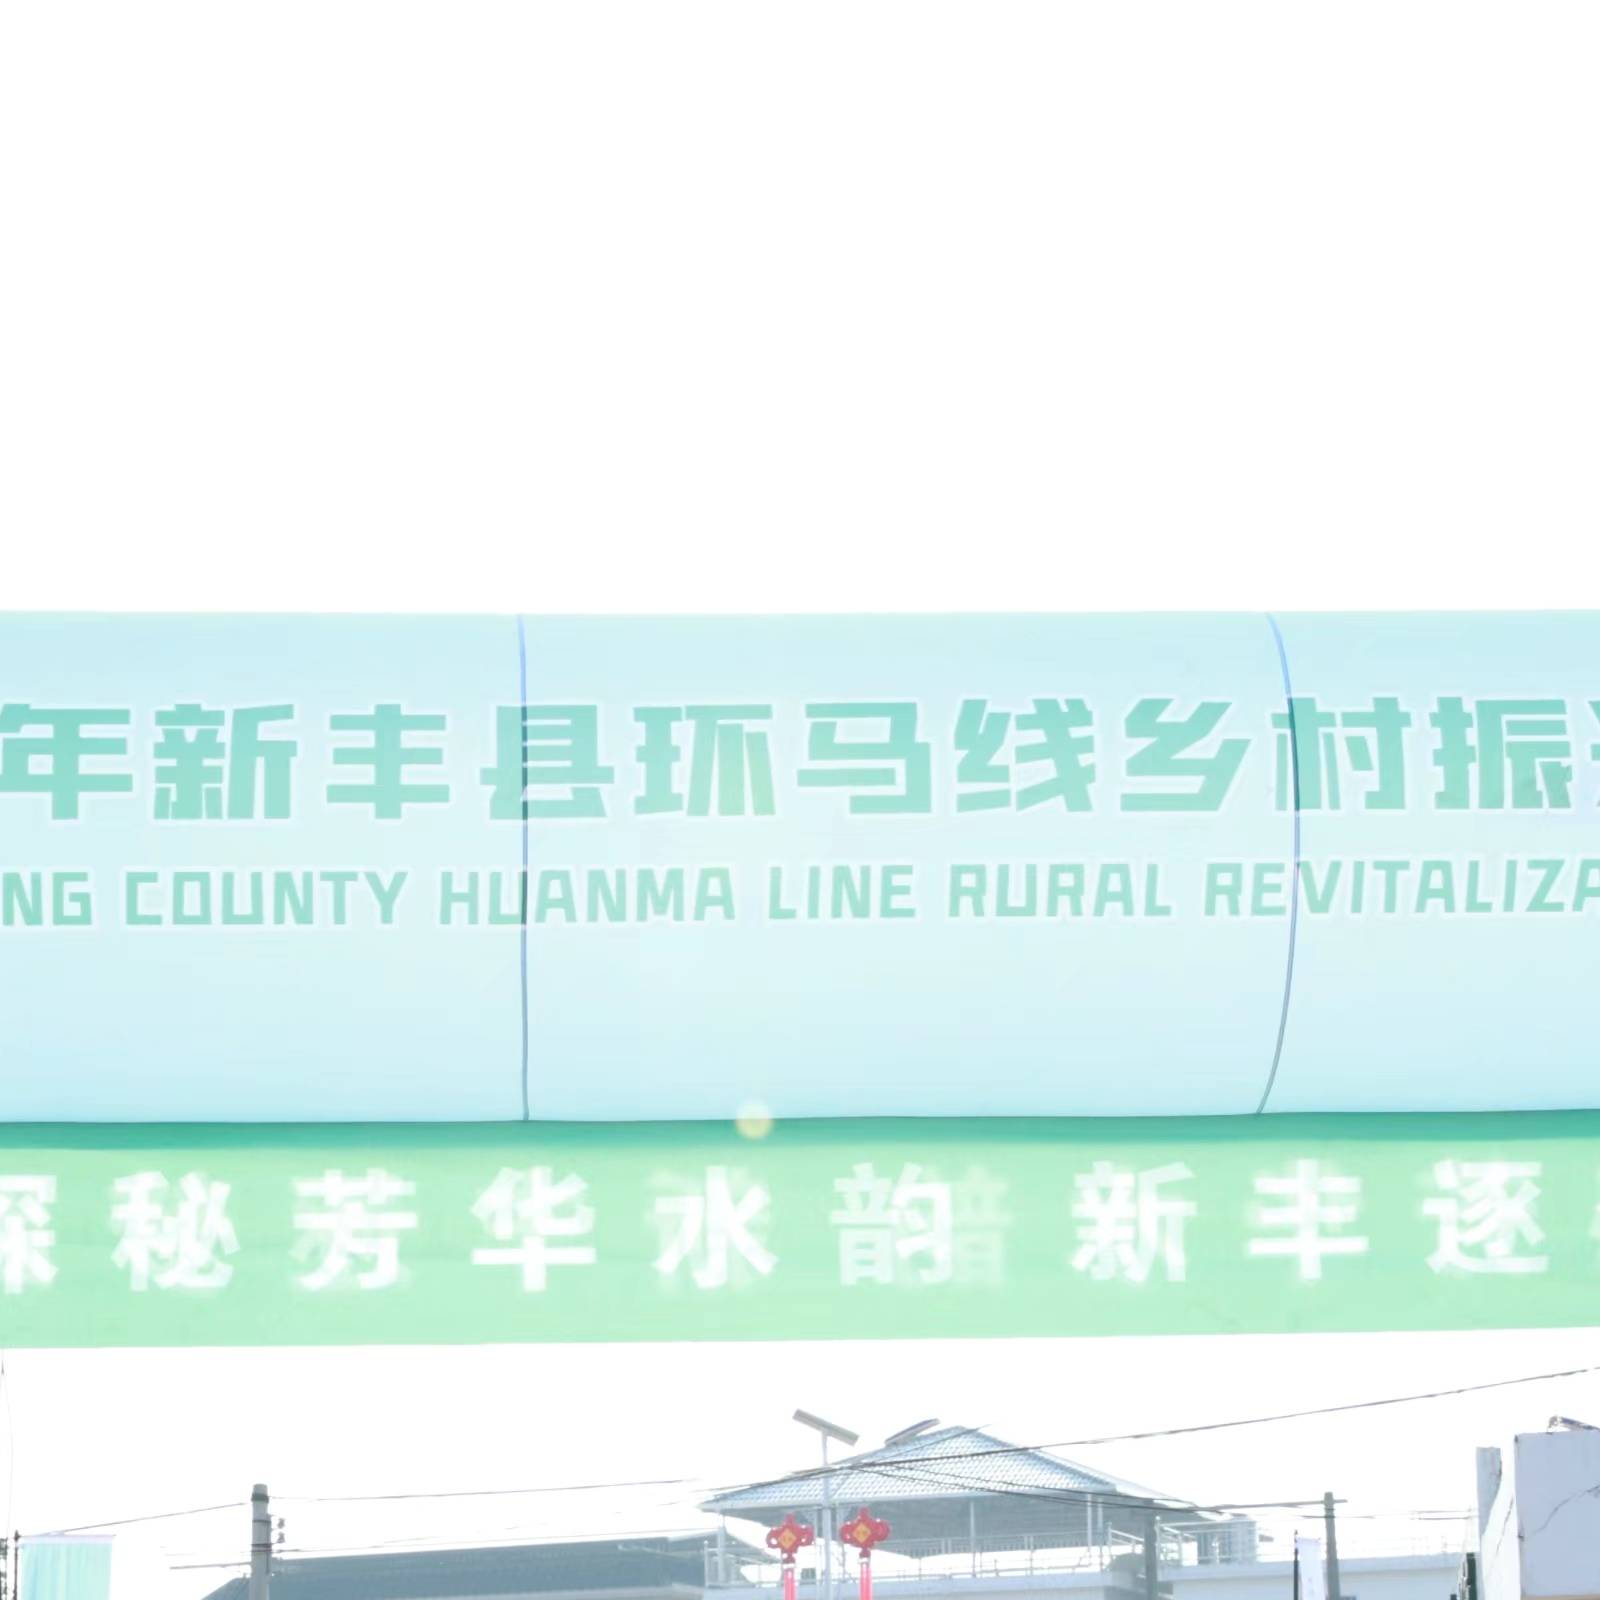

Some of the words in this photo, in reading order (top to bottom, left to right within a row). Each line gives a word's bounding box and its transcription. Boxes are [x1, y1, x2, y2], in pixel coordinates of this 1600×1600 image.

[123, 869, 408, 925] COUNTY
[438, 866, 736, 923] HUANMA
[766, 863, 915, 921] LINE
[946, 860, 1173, 919] RURAL
